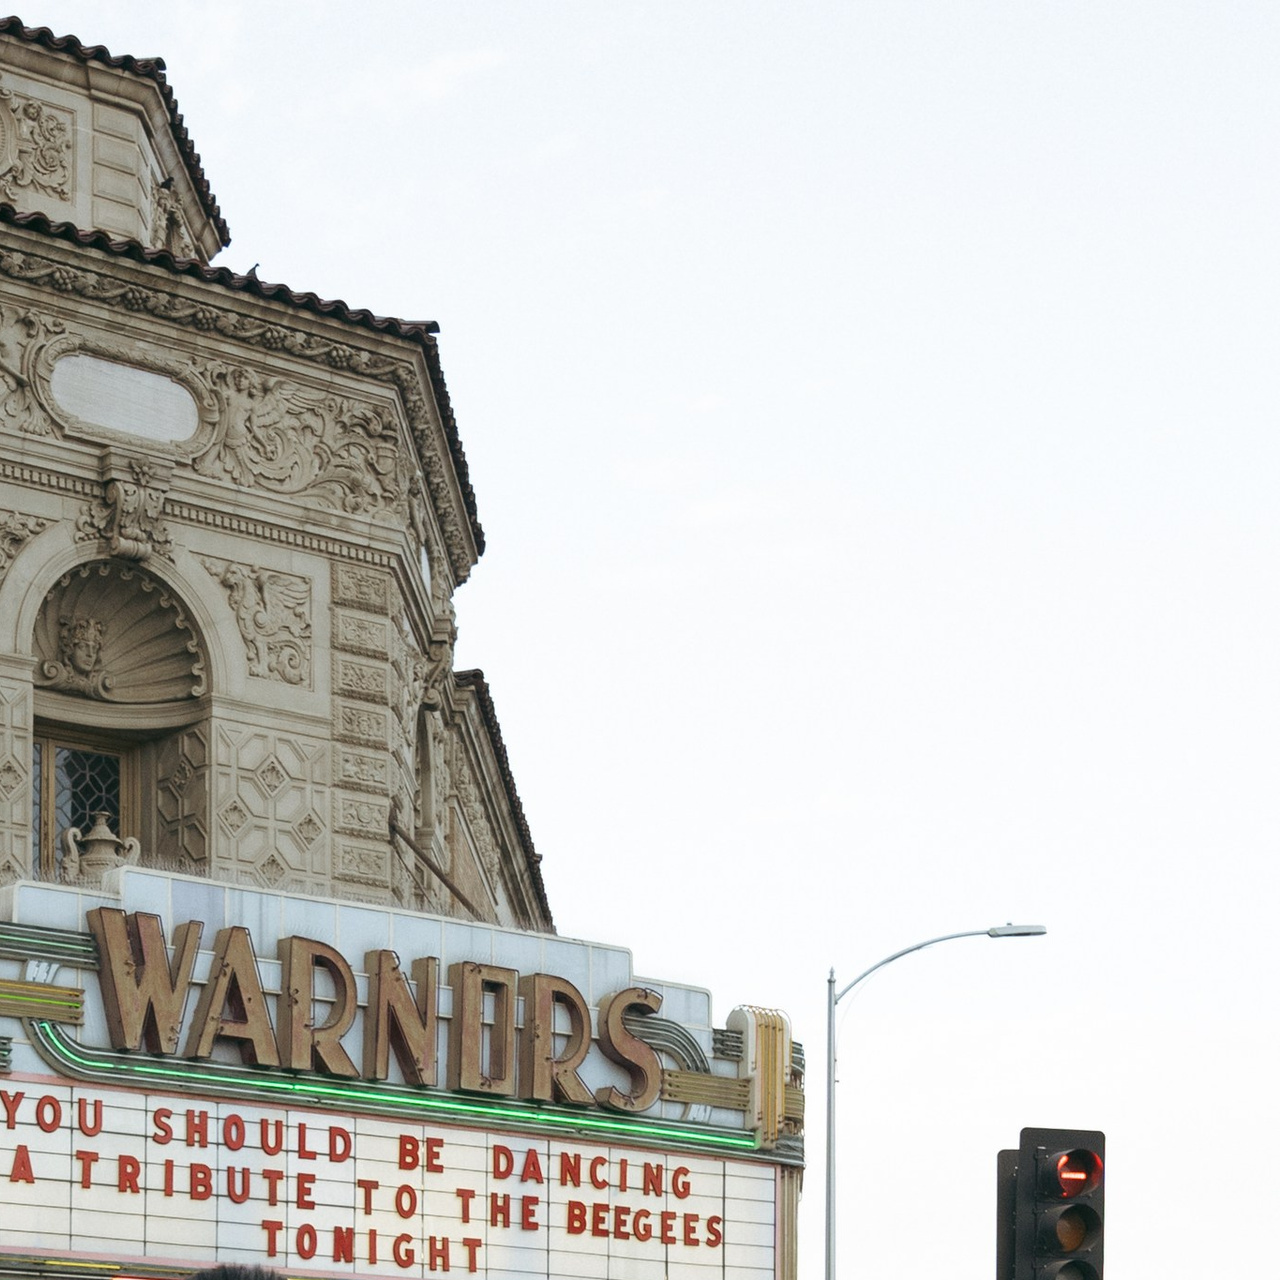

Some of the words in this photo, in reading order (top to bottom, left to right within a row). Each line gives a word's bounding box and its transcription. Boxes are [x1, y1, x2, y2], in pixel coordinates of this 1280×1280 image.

[86, 906, 664, 1113] WARNORS
[9, 1144, 35, 1184] A
[75, 1149, 317, 1211] TRIBUTE
[357, 1179, 418, 1220] TO
[456, 1187, 540, 1231] THE
[567, 1200, 723, 1248] BEEGEES
[152, 1107, 352, 1163] SHOULD
[398, 1134, 444, 1174] BE
[492, 1144, 692, 1200] DANCING
[261, 1219, 483, 1273] TONIGHT
